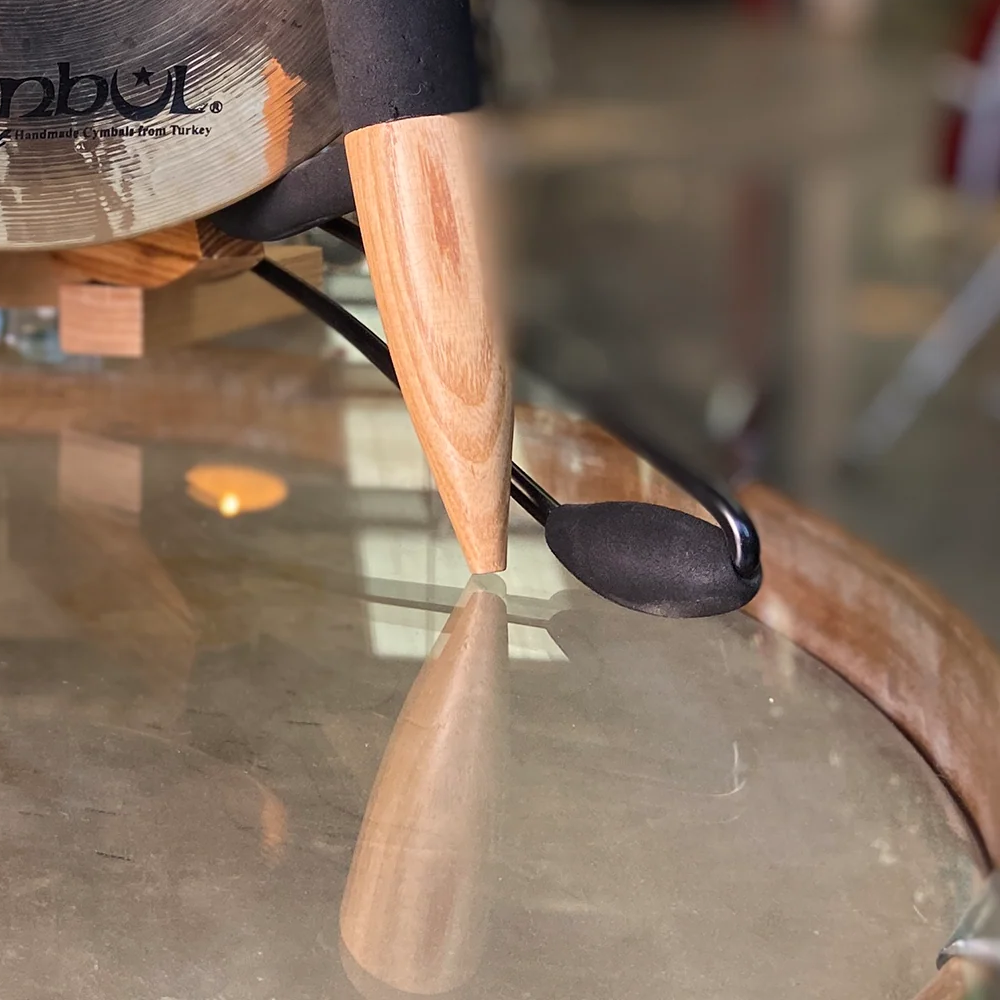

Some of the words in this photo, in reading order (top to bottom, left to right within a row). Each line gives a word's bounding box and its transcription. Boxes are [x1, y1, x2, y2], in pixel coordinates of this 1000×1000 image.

[14, 127, 79, 140] Handmade
[82, 125, 134, 139] Cymbals
[136, 125, 166, 137] from
[169, 124, 212, 137] Turkey
